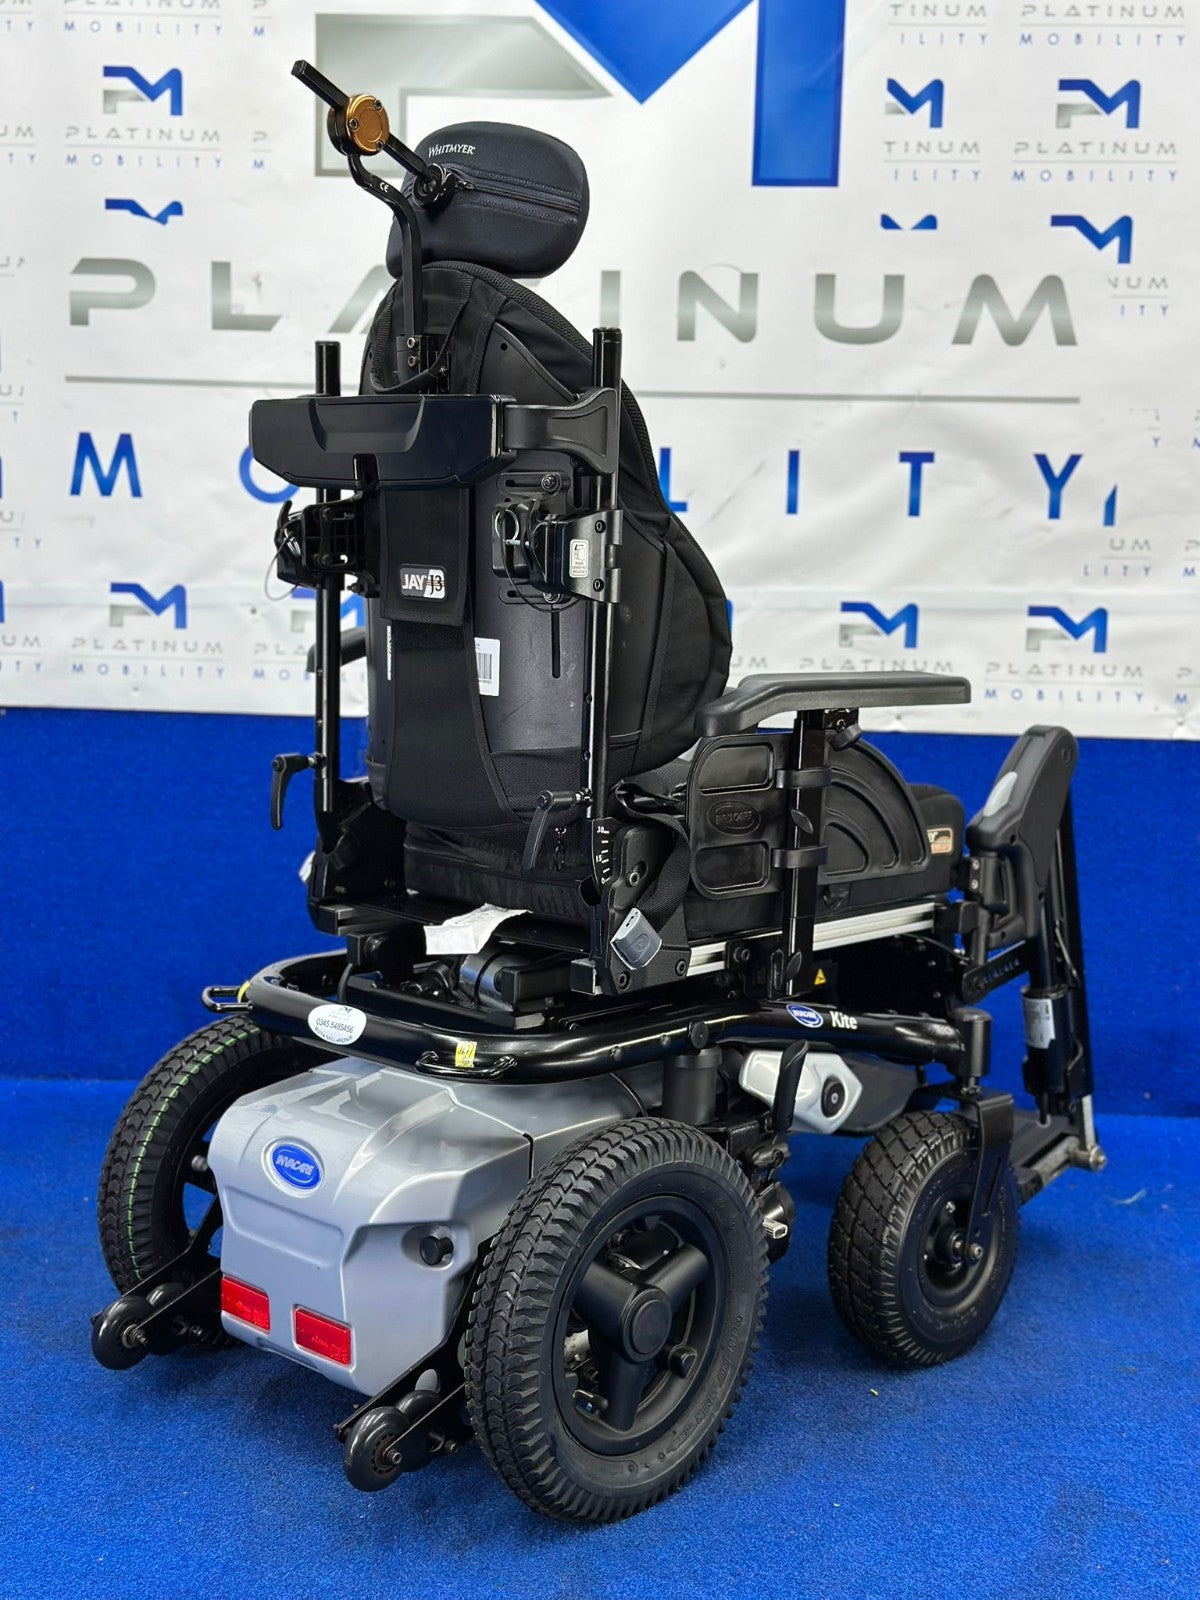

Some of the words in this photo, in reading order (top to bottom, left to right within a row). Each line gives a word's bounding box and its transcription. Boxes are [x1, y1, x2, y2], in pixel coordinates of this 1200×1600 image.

[1021, 4, 1185, 18] PLATINUM
[64, 21, 222, 35] MOBILITY
[1019, 33, 1185, 46] MOBILITY
[65, 126, 221, 141] PLATINUM
[428, 143, 474, 158] WHITMYER
[1013, 141, 1177, 155] PLATINUM
[65, 154, 222, 168] MOBILITY
[1012, 170, 1177, 182] MOBILITY
[402, 574, 426, 590] JAY
[71, 637, 223, 653] PLATINUM
[71, 662, 224, 676] MOBILITY
[799, 657, 954, 673] PLATINUM
[986, 662, 1144, 678] PLATINUM
[984, 688, 1144, 702] MOBILITY
[829, 1010, 858, 1030] Kite
[275, 1154, 315, 1176] INVACARE
